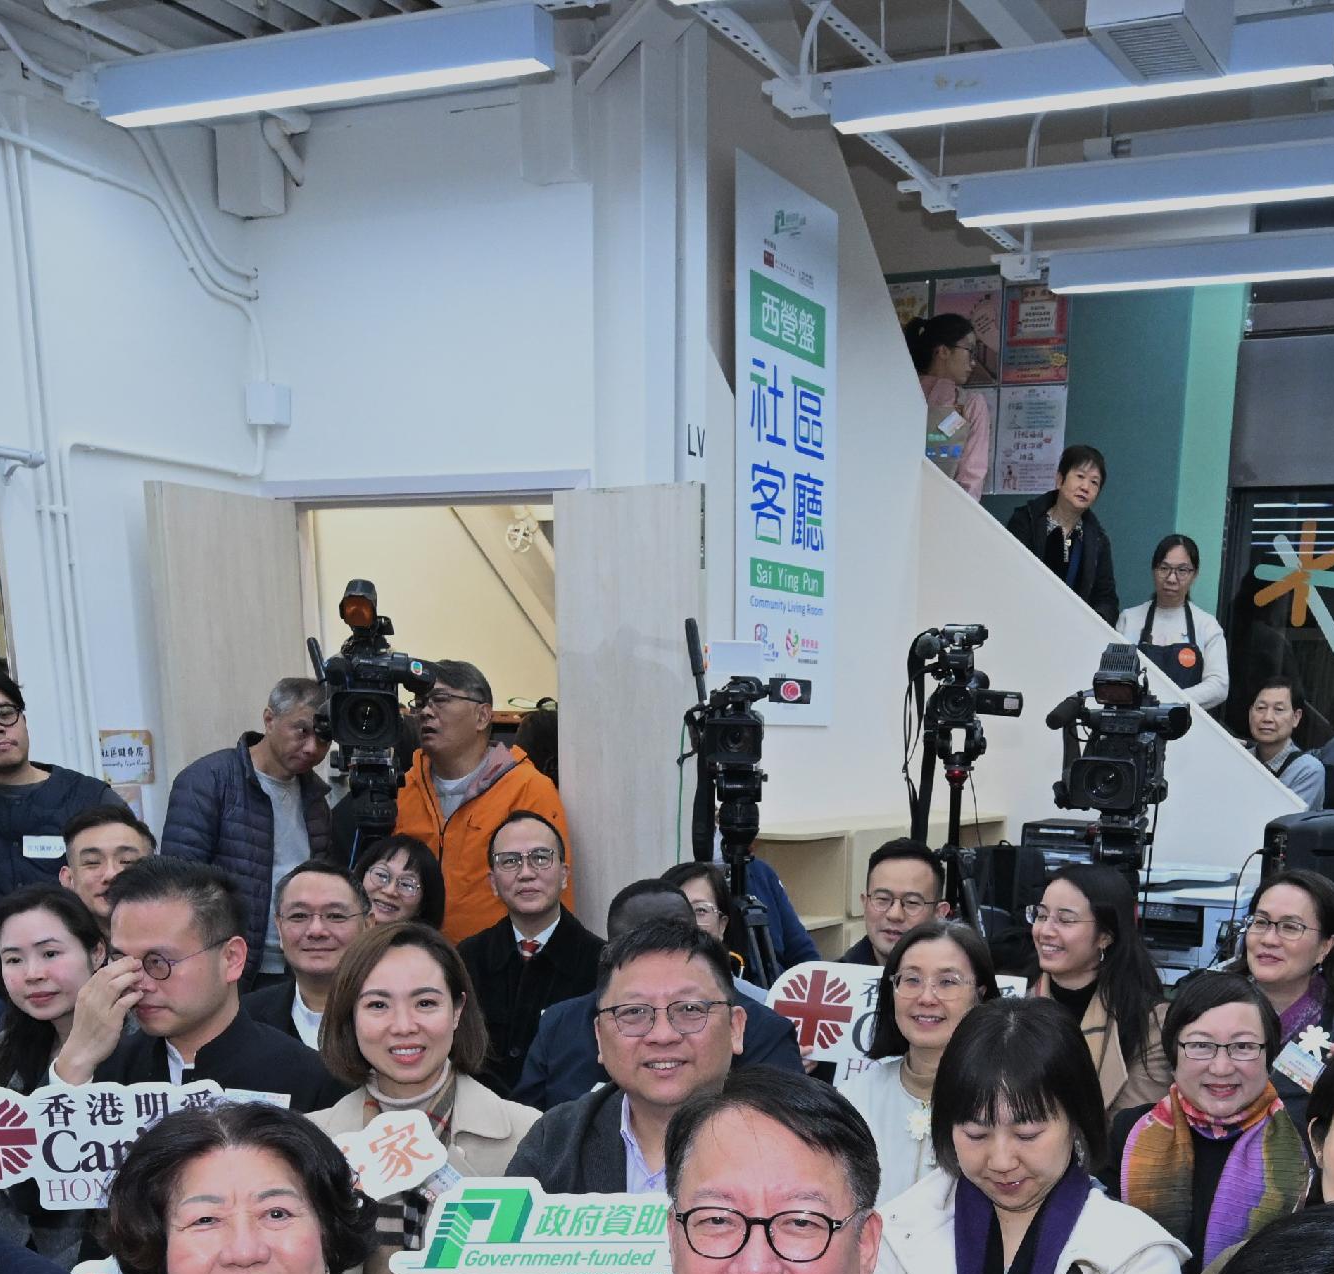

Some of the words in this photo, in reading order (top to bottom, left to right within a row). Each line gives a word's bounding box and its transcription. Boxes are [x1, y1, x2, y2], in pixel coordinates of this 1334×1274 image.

[761, 292, 816, 354] 西營盤
[750, 357, 825, 460] 社區
[750, 460, 824, 551] 客廳
[756, 563, 772, 584] Sai
[778, 567, 799, 592] Ying
[802, 572, 819, 592] Pun
[750, 595, 786, 613] Community
[788, 602, 805, 616] Living
[807, 604, 824, 616] Room
[534, 1204, 667, 1237] 政府資助
[465, 1249, 656, 1268] Government-funded
